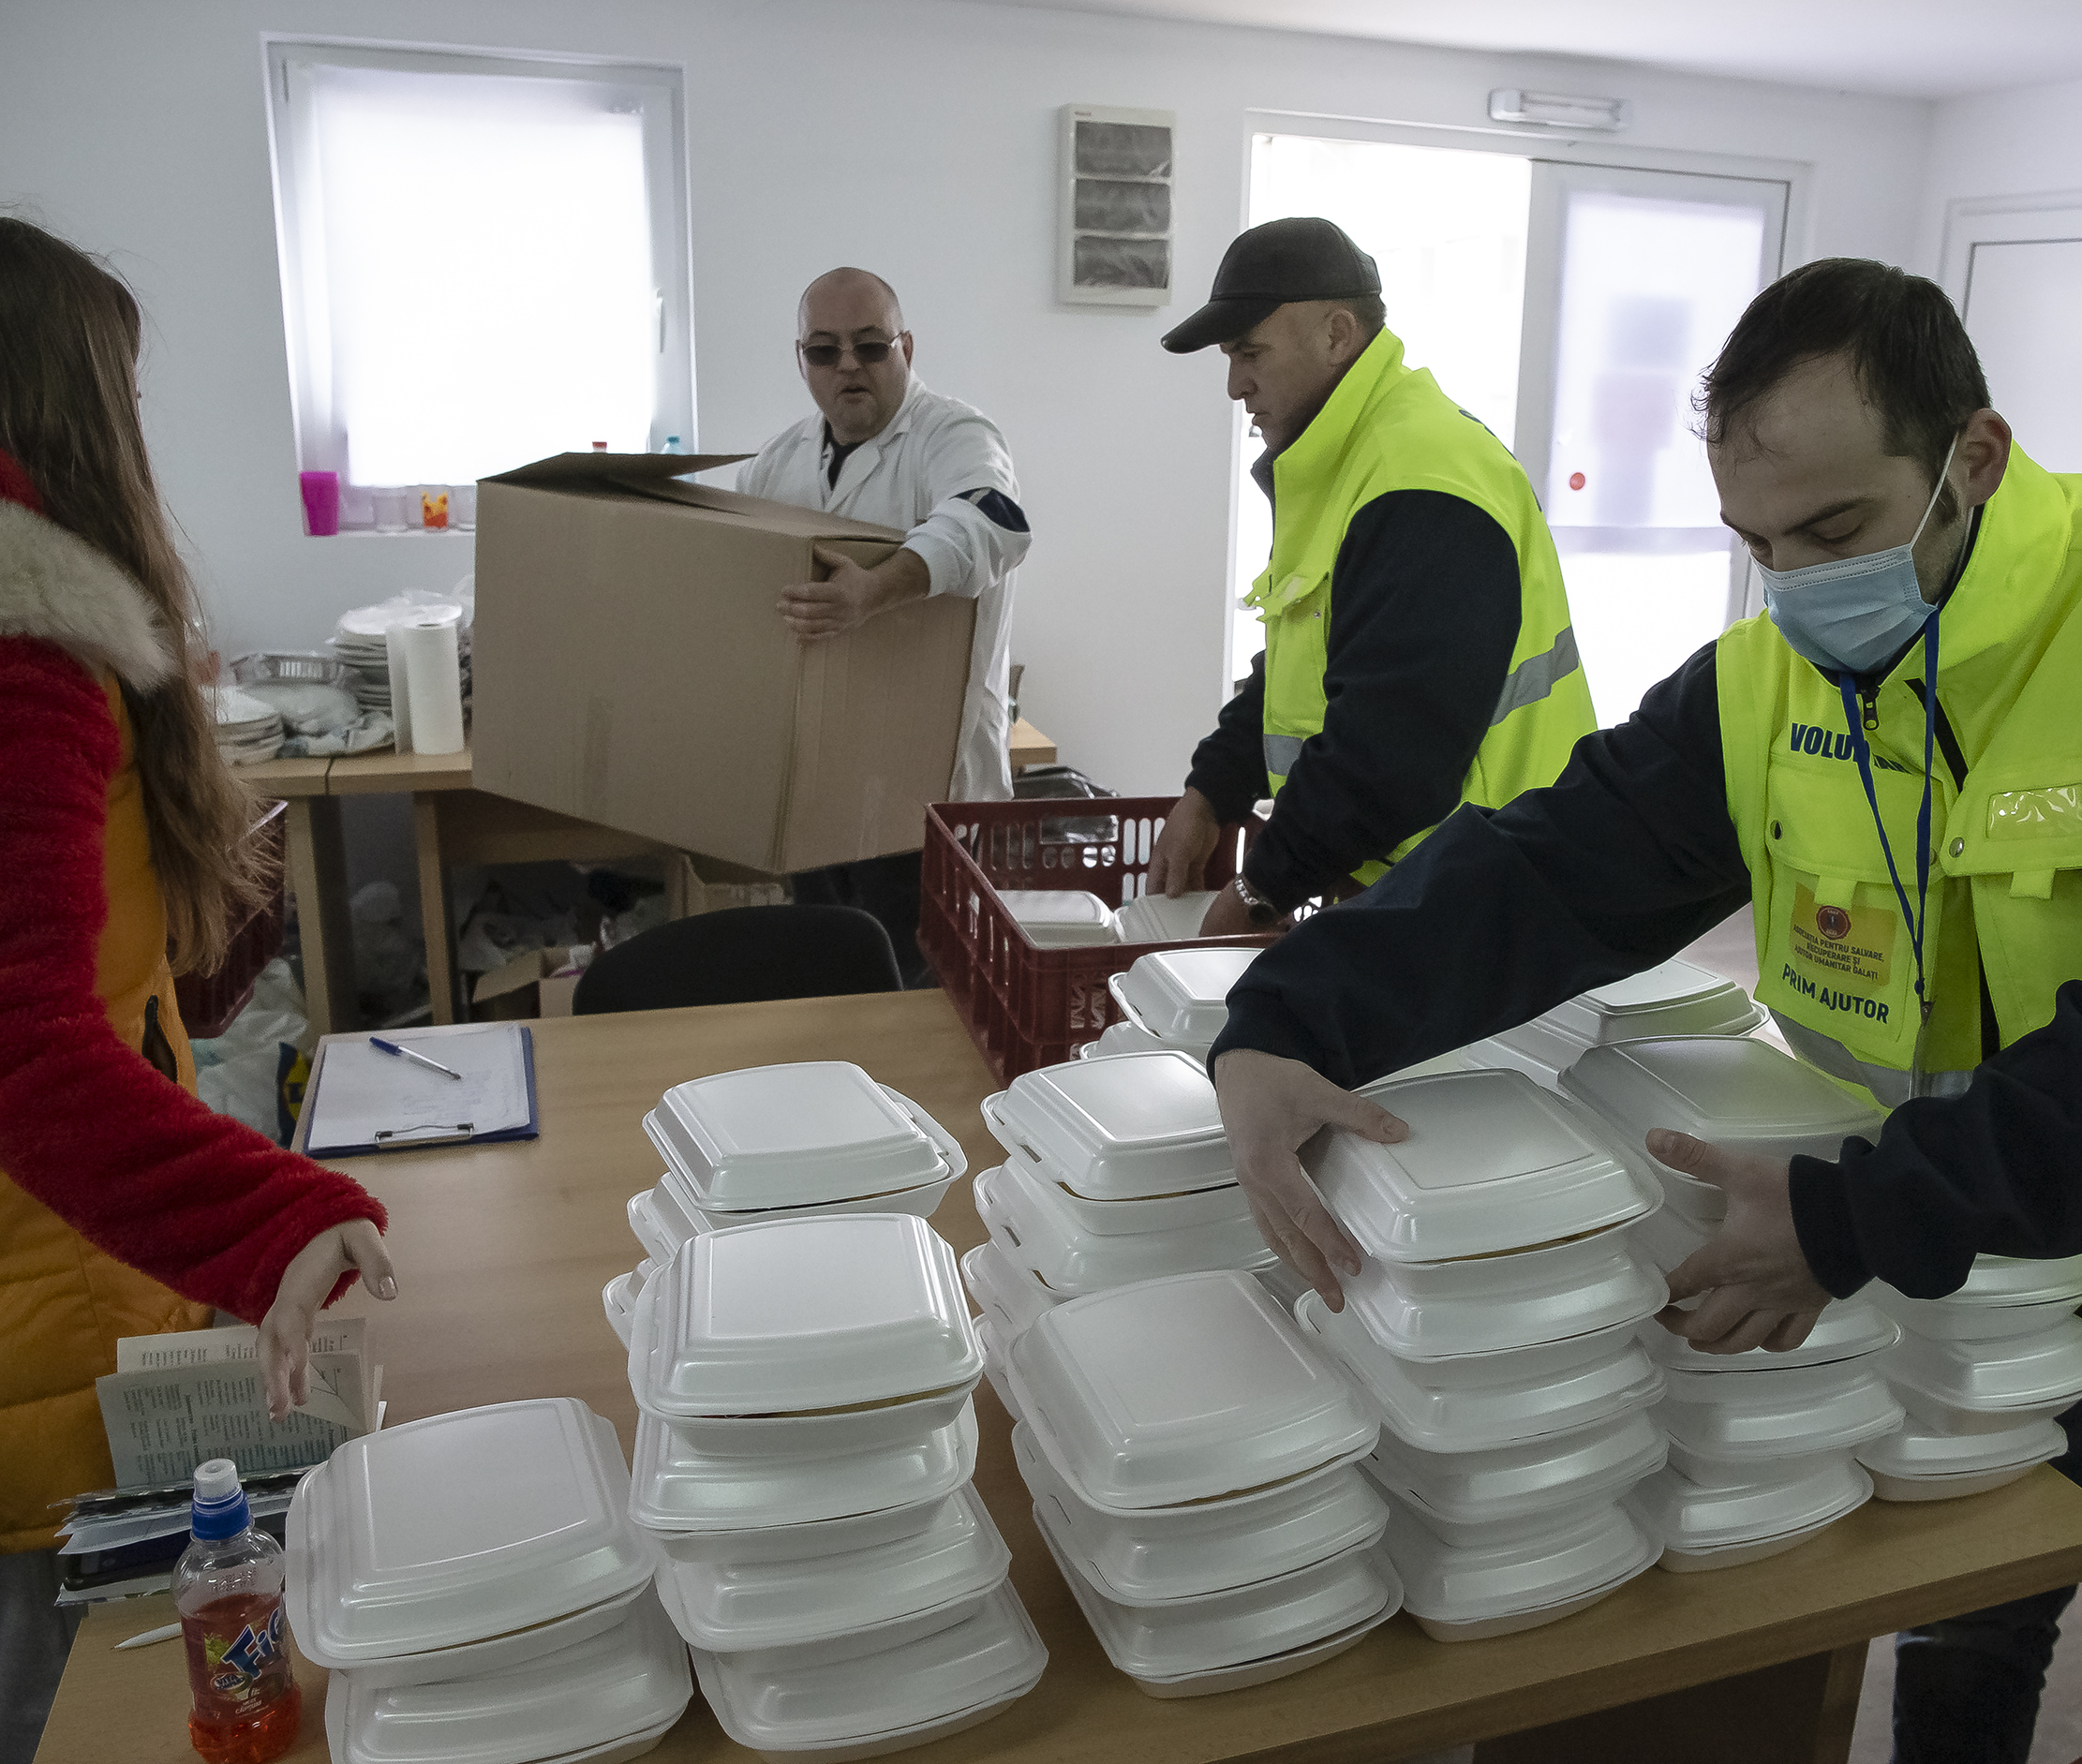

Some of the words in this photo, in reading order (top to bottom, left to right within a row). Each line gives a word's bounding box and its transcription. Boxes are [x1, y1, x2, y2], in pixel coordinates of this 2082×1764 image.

[1807, 942, 1851, 963] RECUPERARE
[1820, 940, 1850, 954] PENTRU
[1814, 954, 1851, 973] UMANITAR
[1782, 963, 1816, 1000] PRIM
[1820, 986, 1889, 1024] AJUTOR
